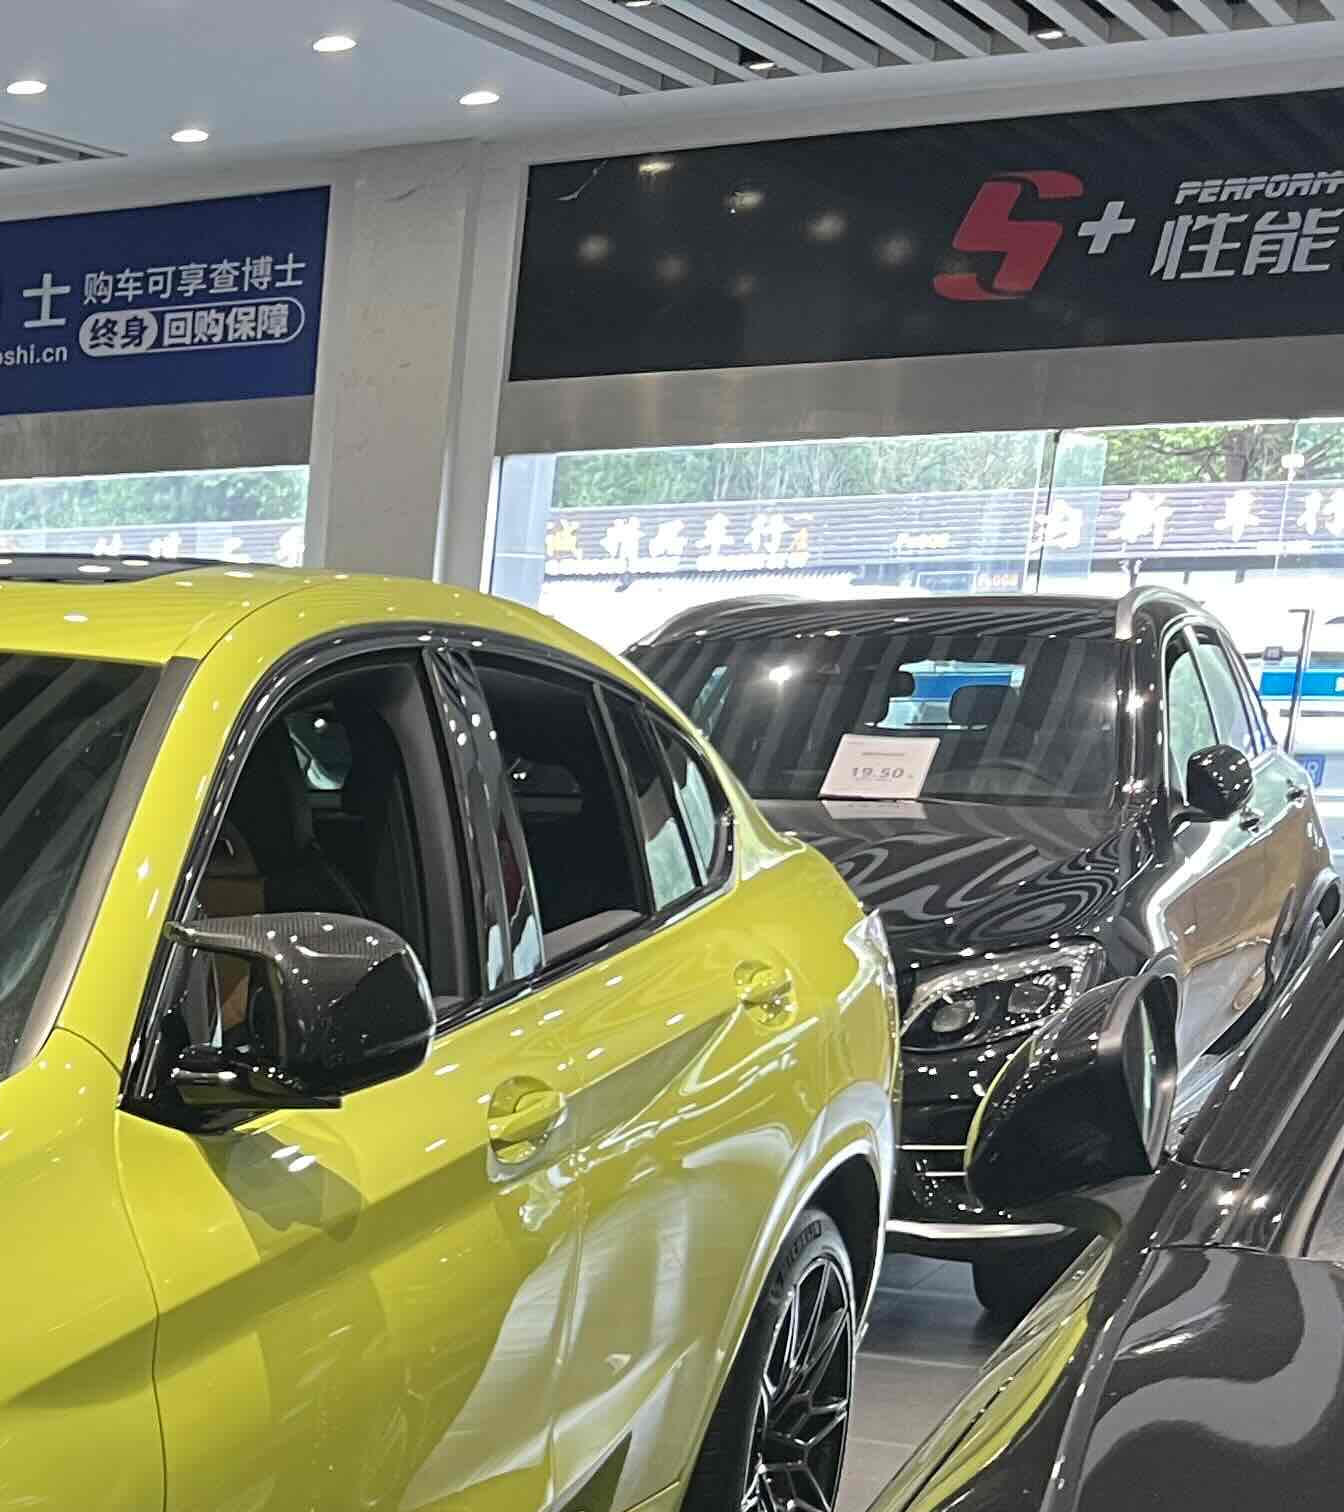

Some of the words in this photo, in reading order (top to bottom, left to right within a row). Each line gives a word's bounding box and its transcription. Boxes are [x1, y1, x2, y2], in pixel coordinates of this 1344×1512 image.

[1150, 207, 1344, 281] 性能
[83, 252, 306, 305] 购车可享查博士
[89, 315, 149, 350] 终身
[162, 303, 289, 347] 回购保障
